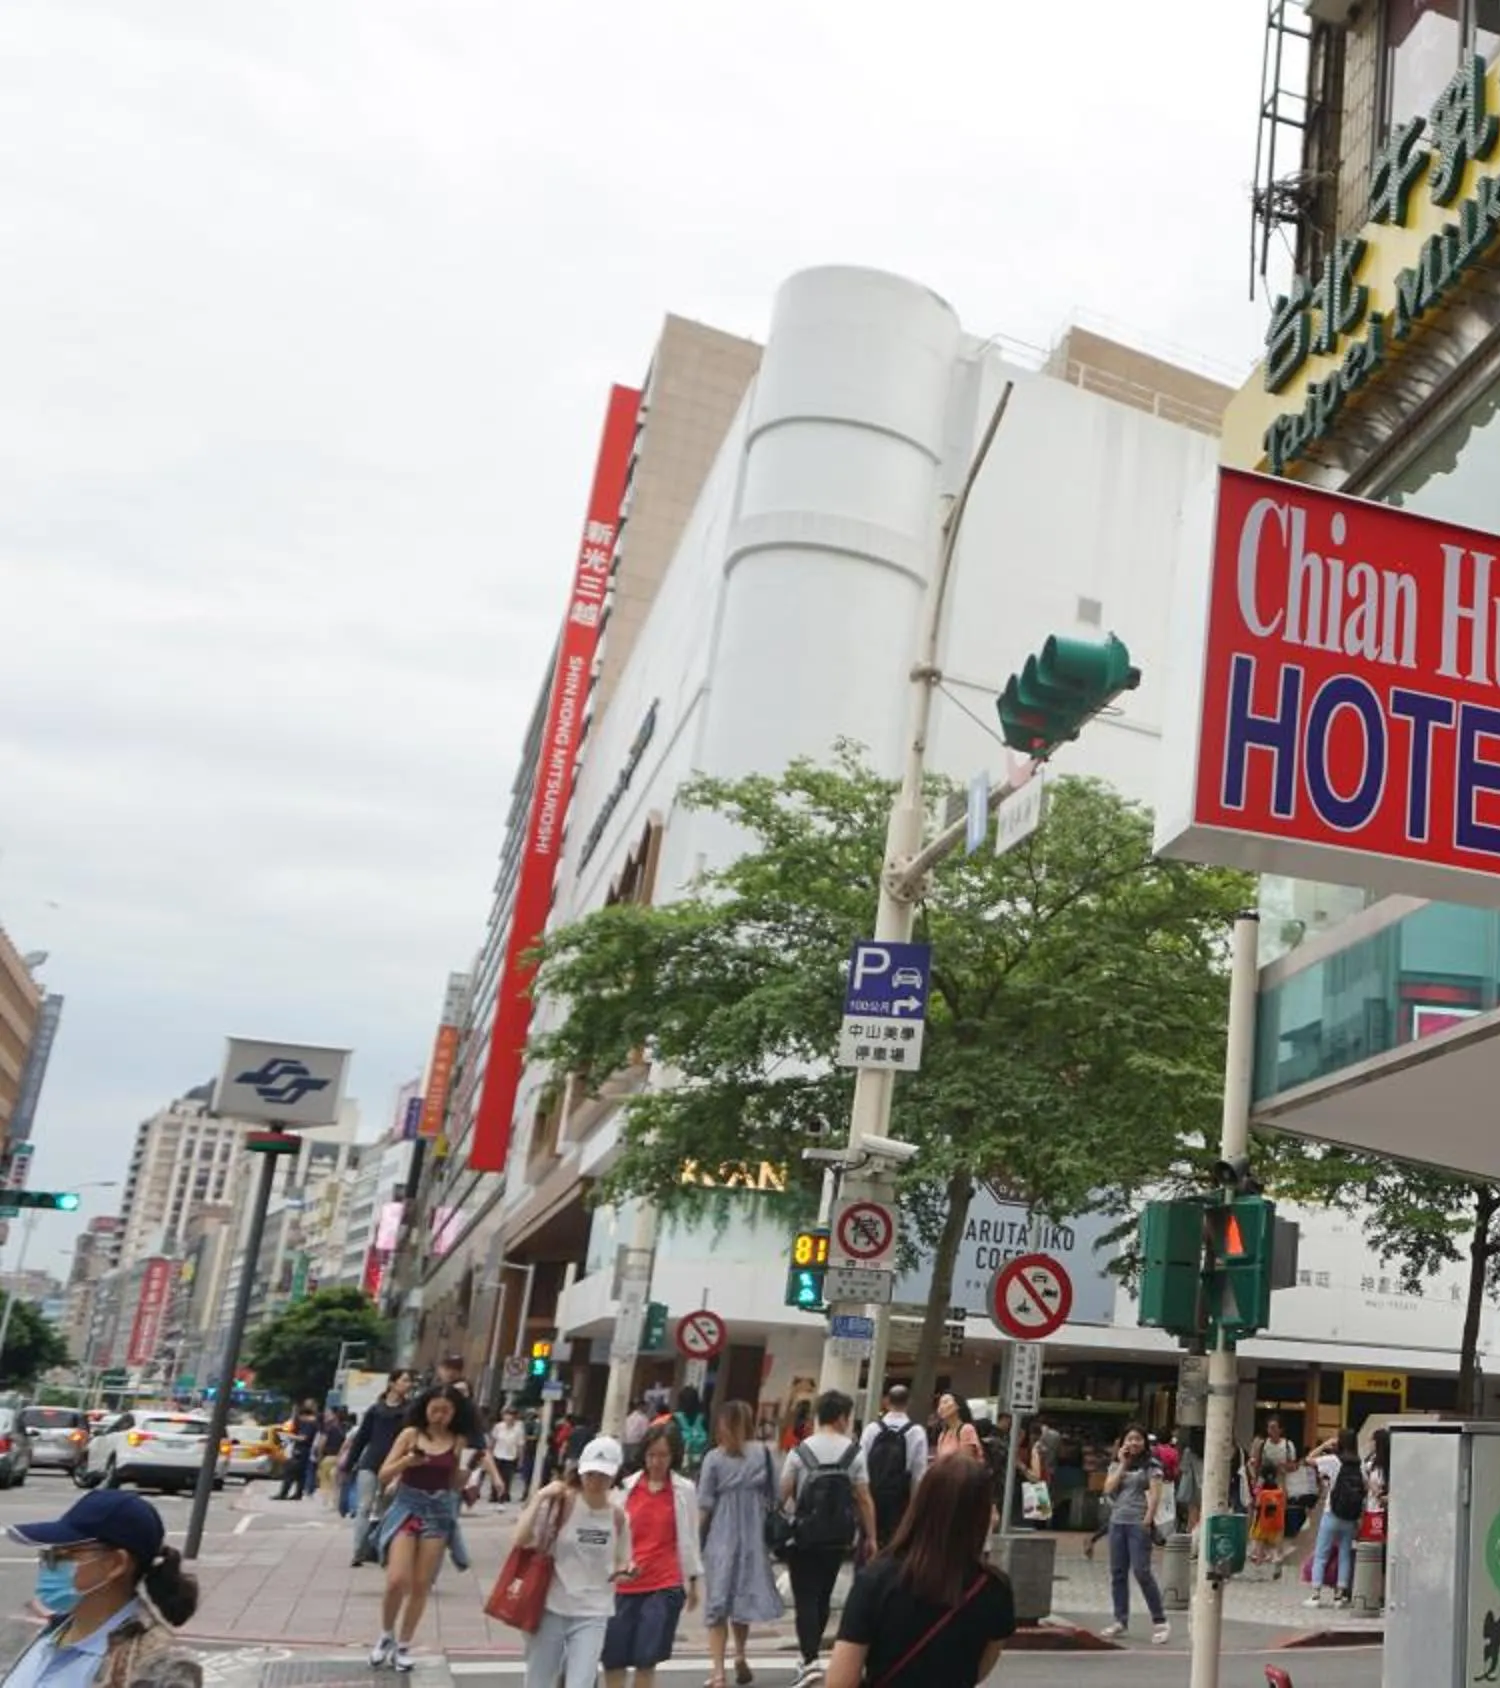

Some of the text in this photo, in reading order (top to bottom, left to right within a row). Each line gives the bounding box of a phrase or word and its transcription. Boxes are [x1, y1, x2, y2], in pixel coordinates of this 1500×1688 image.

[1264, 236, 1368, 394] 台北
[1264, 311, 1383, 475] Taipei
[1237, 498, 1417, 669] Chian
[854, 947, 891, 990] P
[795, 1234, 827, 1264] 81
